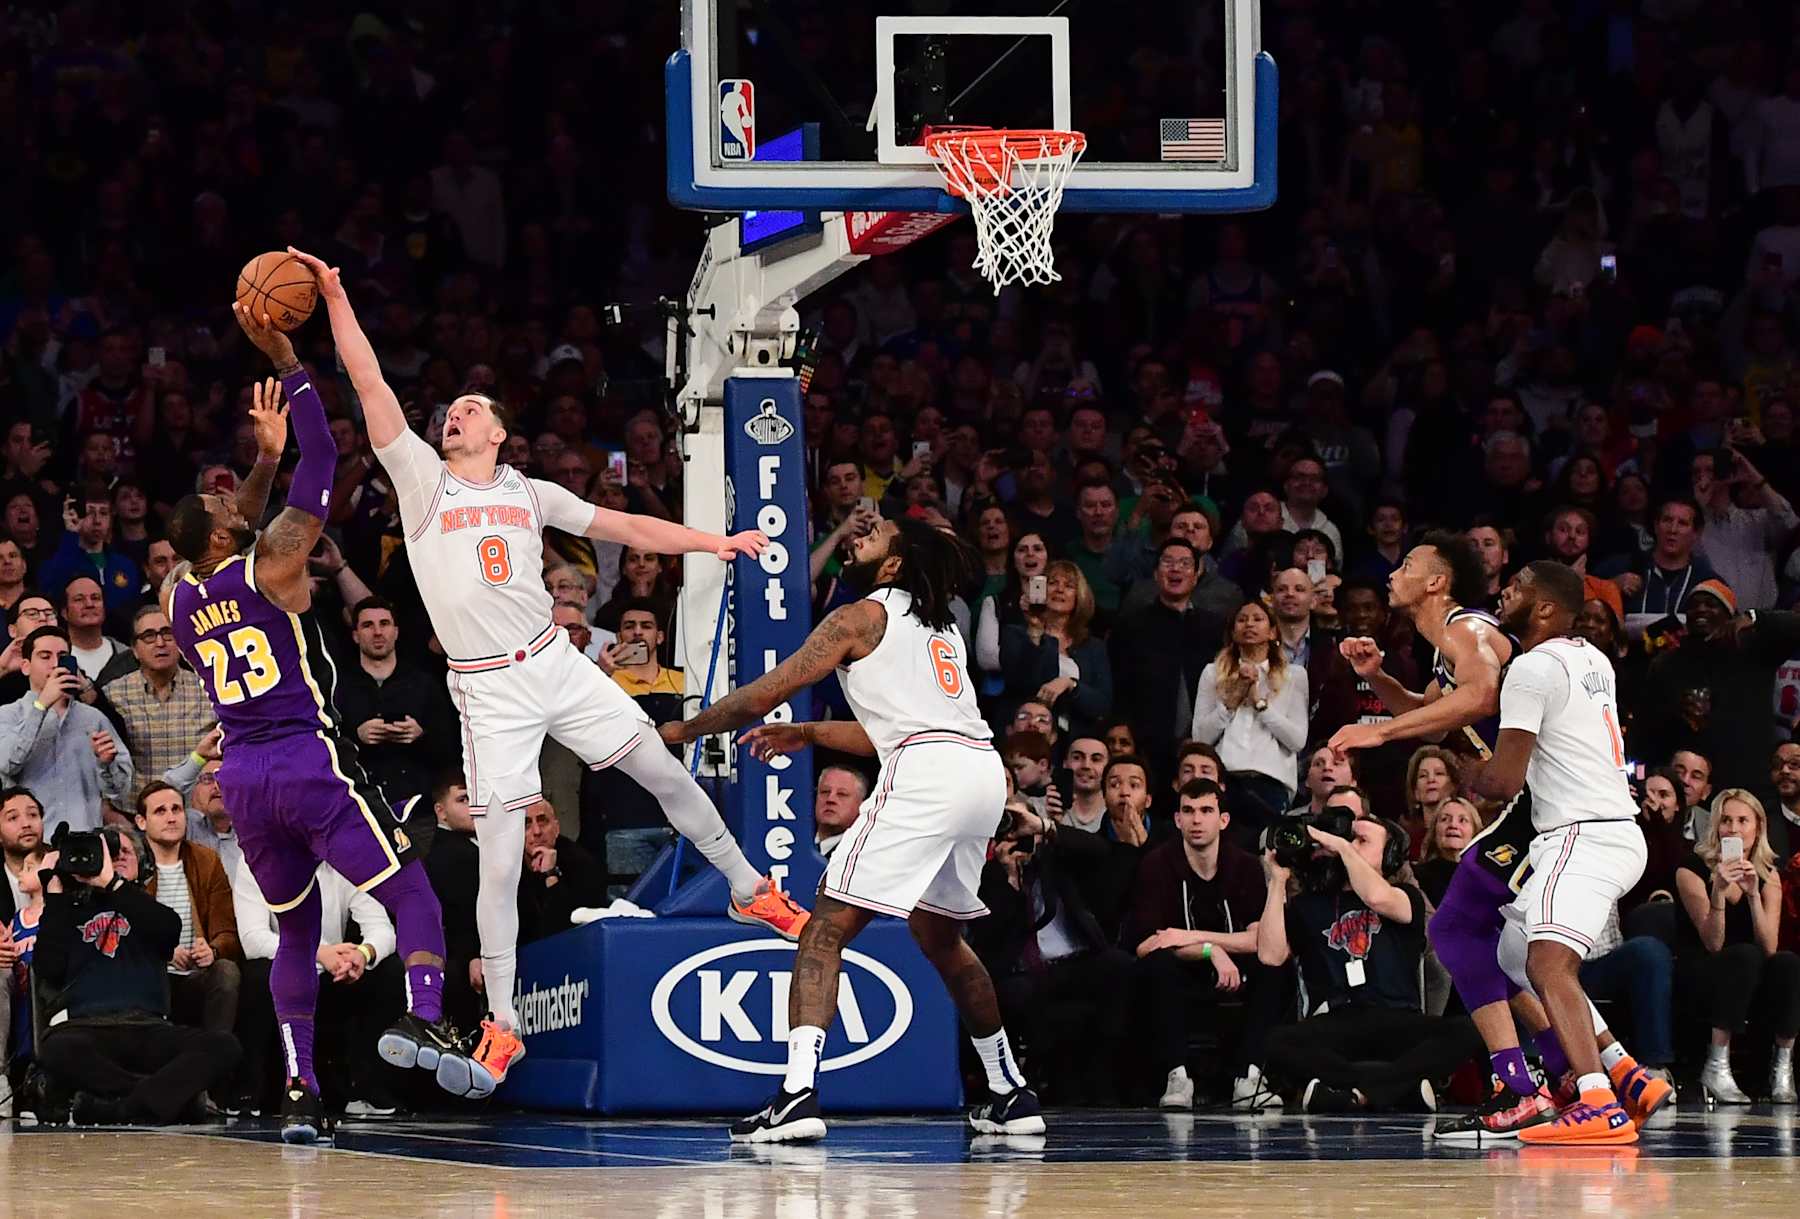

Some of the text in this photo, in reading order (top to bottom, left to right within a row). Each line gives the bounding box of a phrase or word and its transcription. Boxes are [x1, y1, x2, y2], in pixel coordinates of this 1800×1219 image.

[723, 142, 742, 157] NBA
[440, 504, 532, 535] NEW YORK
[757, 455, 789, 620] Foot
[476, 534, 513, 587] 8
[190, 599, 242, 637] JAMES
[194, 625, 282, 706] 23
[927, 634, 964, 700] 6
